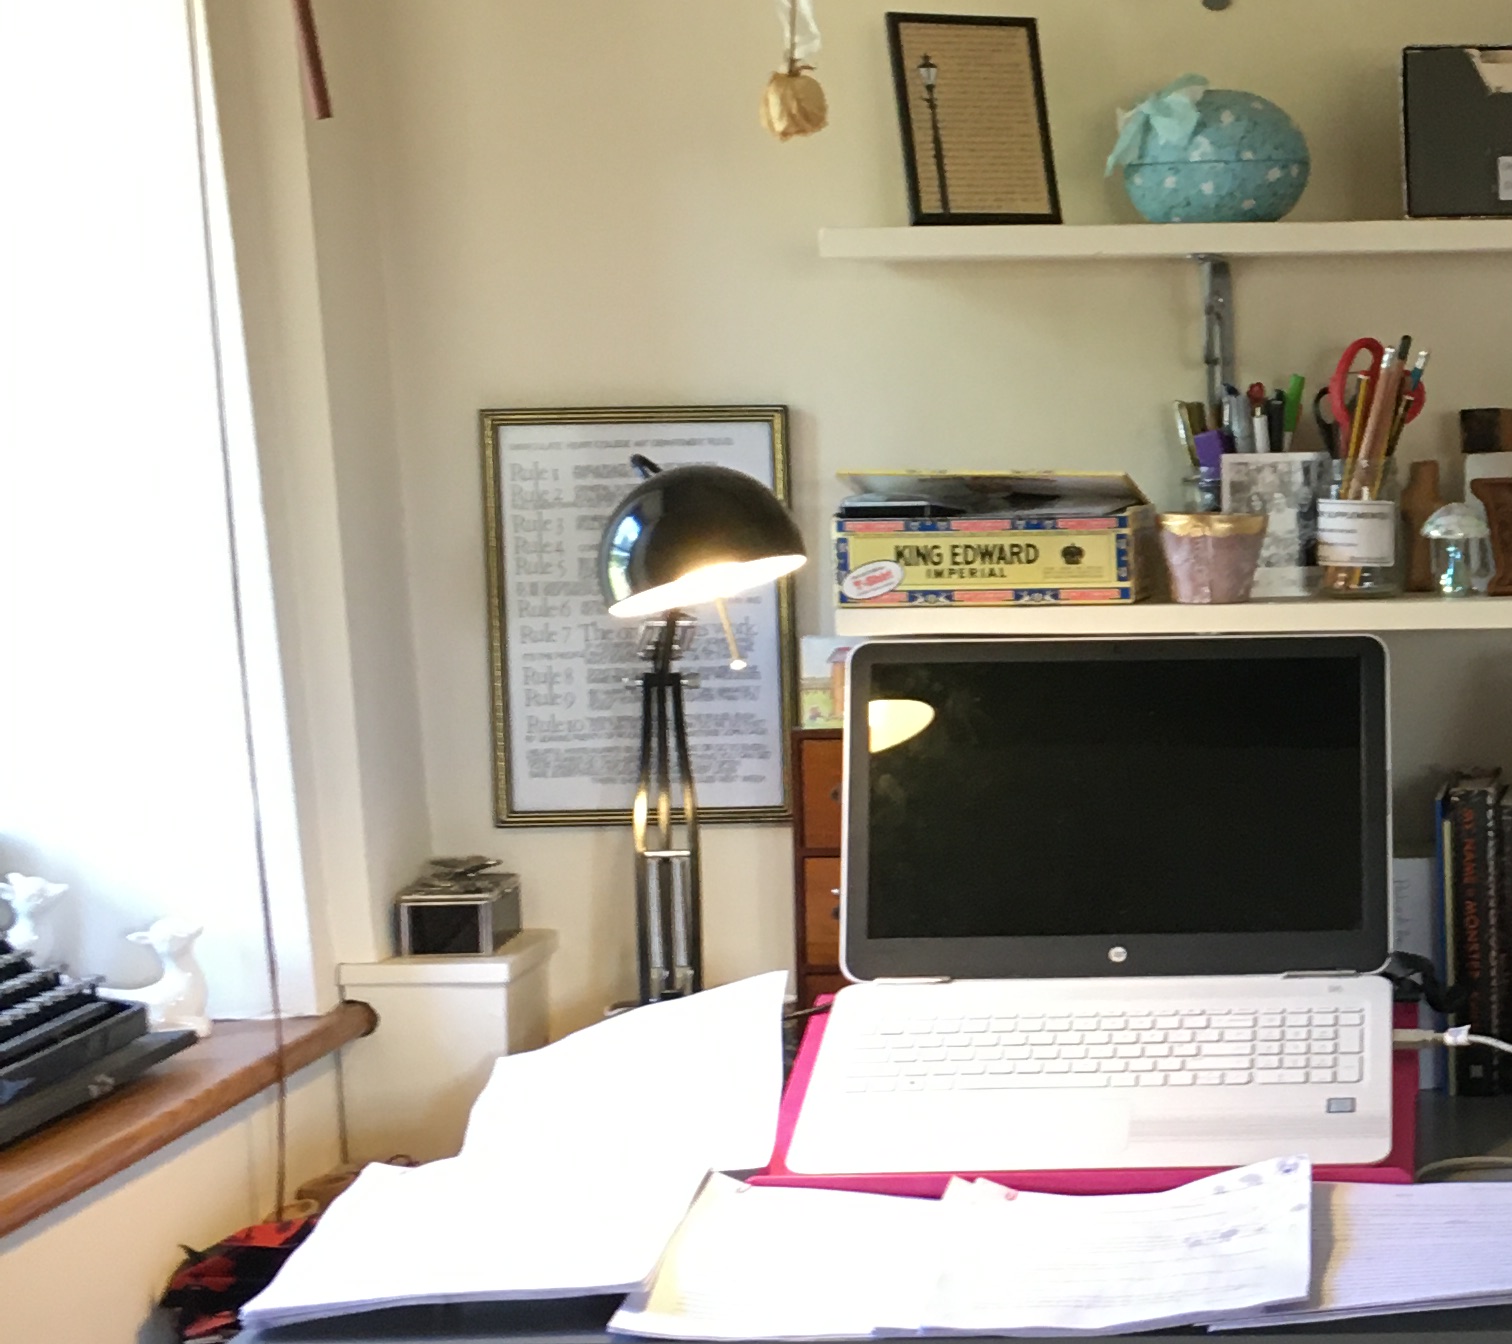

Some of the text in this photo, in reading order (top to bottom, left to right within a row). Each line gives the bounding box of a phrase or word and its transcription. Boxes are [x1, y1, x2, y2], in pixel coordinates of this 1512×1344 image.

[510, 463, 549, 483] Rule
[894, 544, 1040, 566] KING EDWARD
[514, 557, 554, 575] Rule
[926, 567, 1007, 580] IMPERIAL
[517, 599, 557, 619] Rule
[518, 622, 559, 644] Rule
[583, 624, 617, 641] The
[1462, 838, 1478, 884] NAME
[1464, 900, 1481, 979] MONSTER
